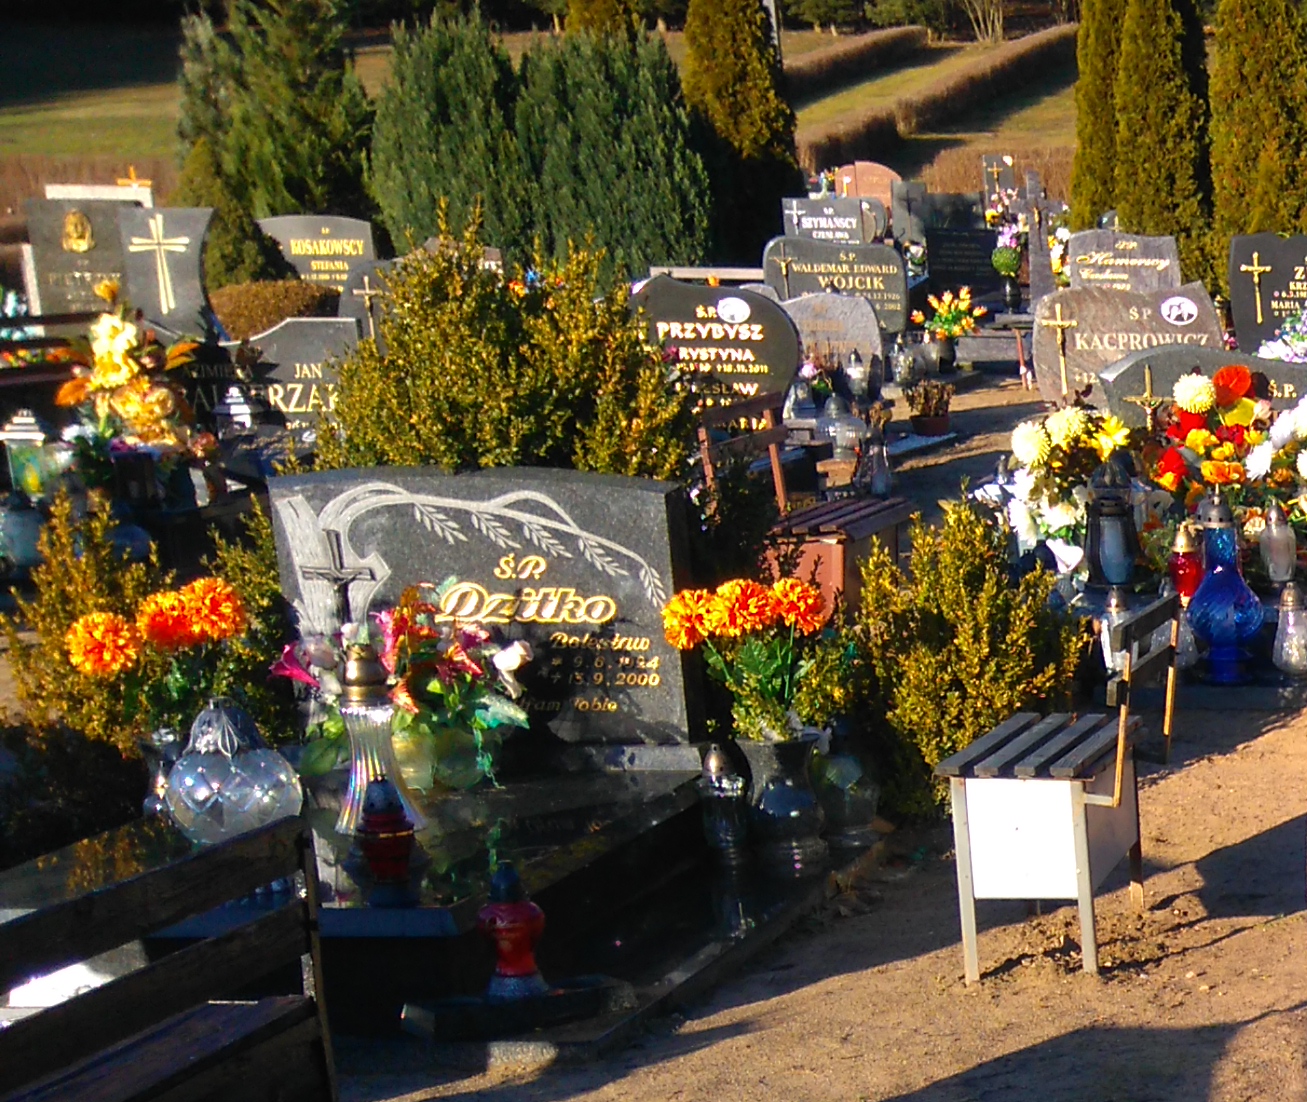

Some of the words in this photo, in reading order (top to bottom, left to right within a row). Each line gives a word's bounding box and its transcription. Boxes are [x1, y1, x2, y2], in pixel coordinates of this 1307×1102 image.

[791, 262, 850, 273] WALDEMAR
[854, 263, 898, 274] EDWARD
[818, 275, 885, 290] WÓJCIK
[1271, 300, 1300, 309] MARIA
[656, 322, 764, 341] PRZYBYSZ
[294, 363, 323, 379] JAN
[1268, 379, 1298, 398] Ś.P.
[493, 553, 547, 580] Ś.P.
